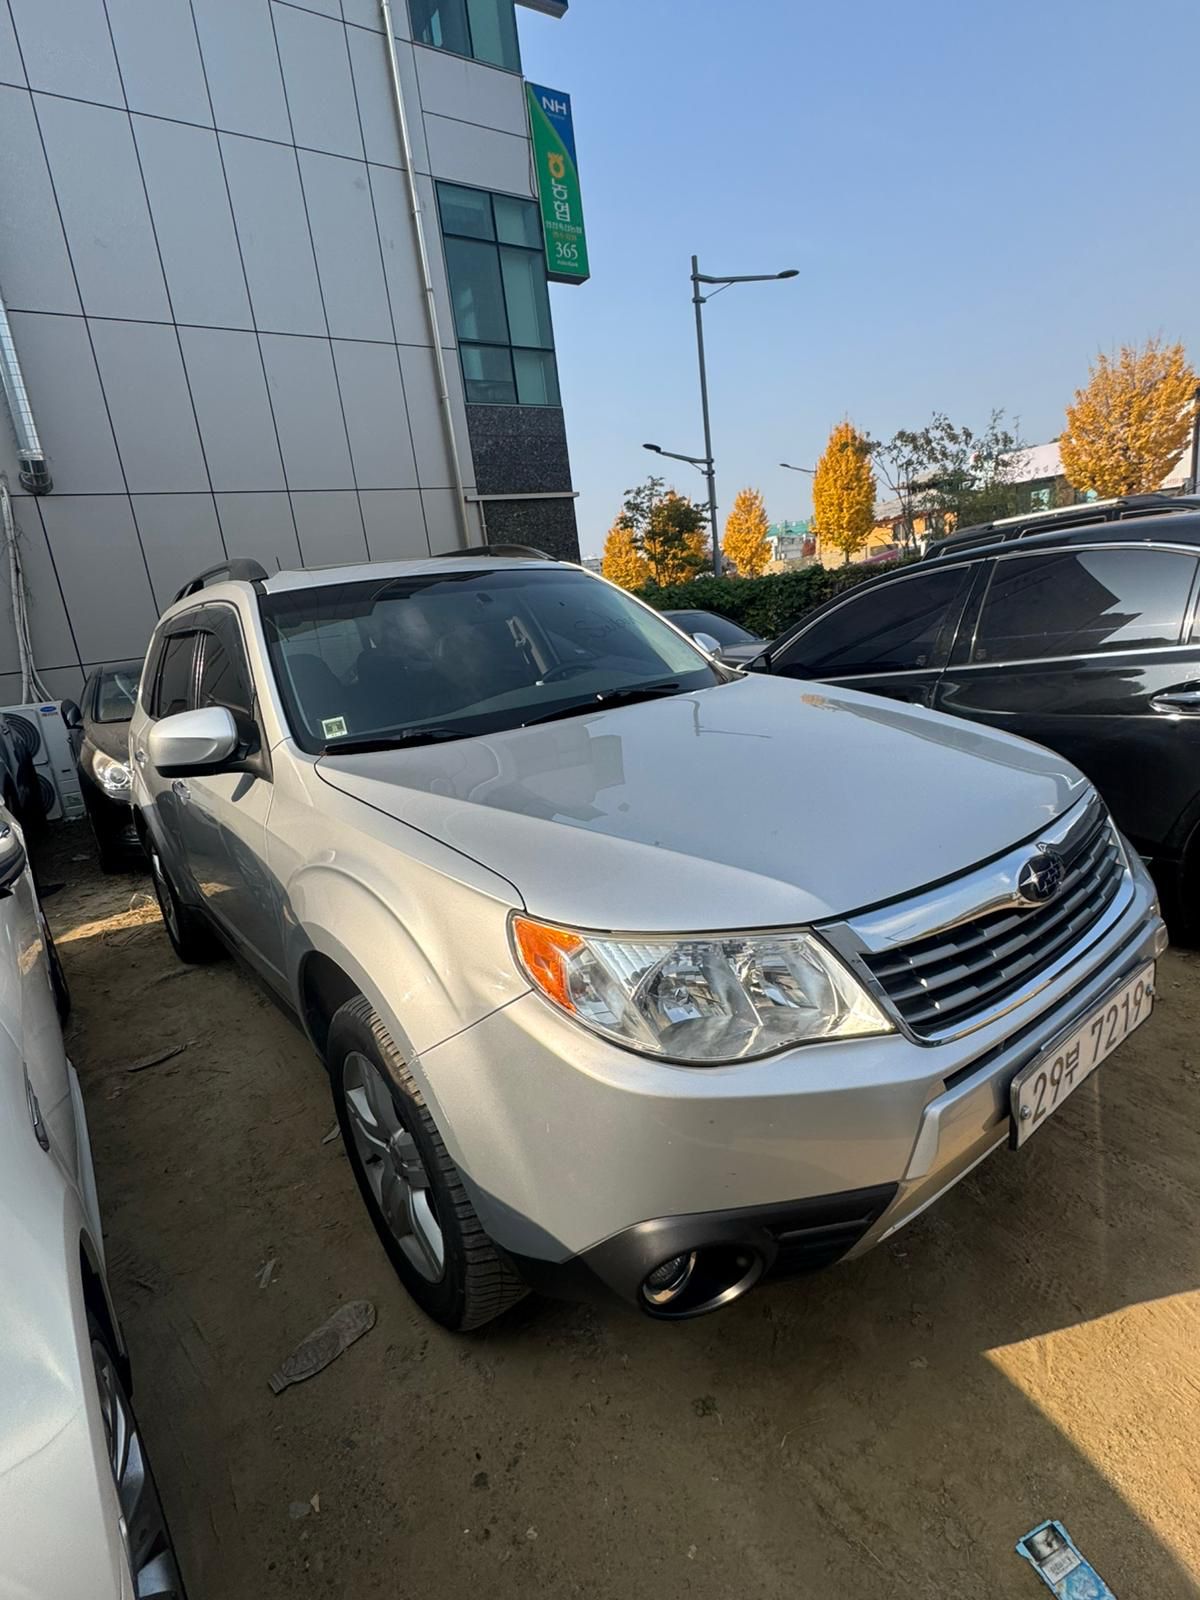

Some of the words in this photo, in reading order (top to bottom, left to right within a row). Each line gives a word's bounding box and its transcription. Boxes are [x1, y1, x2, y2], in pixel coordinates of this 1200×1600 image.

[542, 96, 567, 115] NH
[551, 178, 570, 222] 농협
[555, 241, 578, 260] 365
[1031, 1040, 1081, 1126] 29부
[1090, 980, 1145, 1063] 7219
